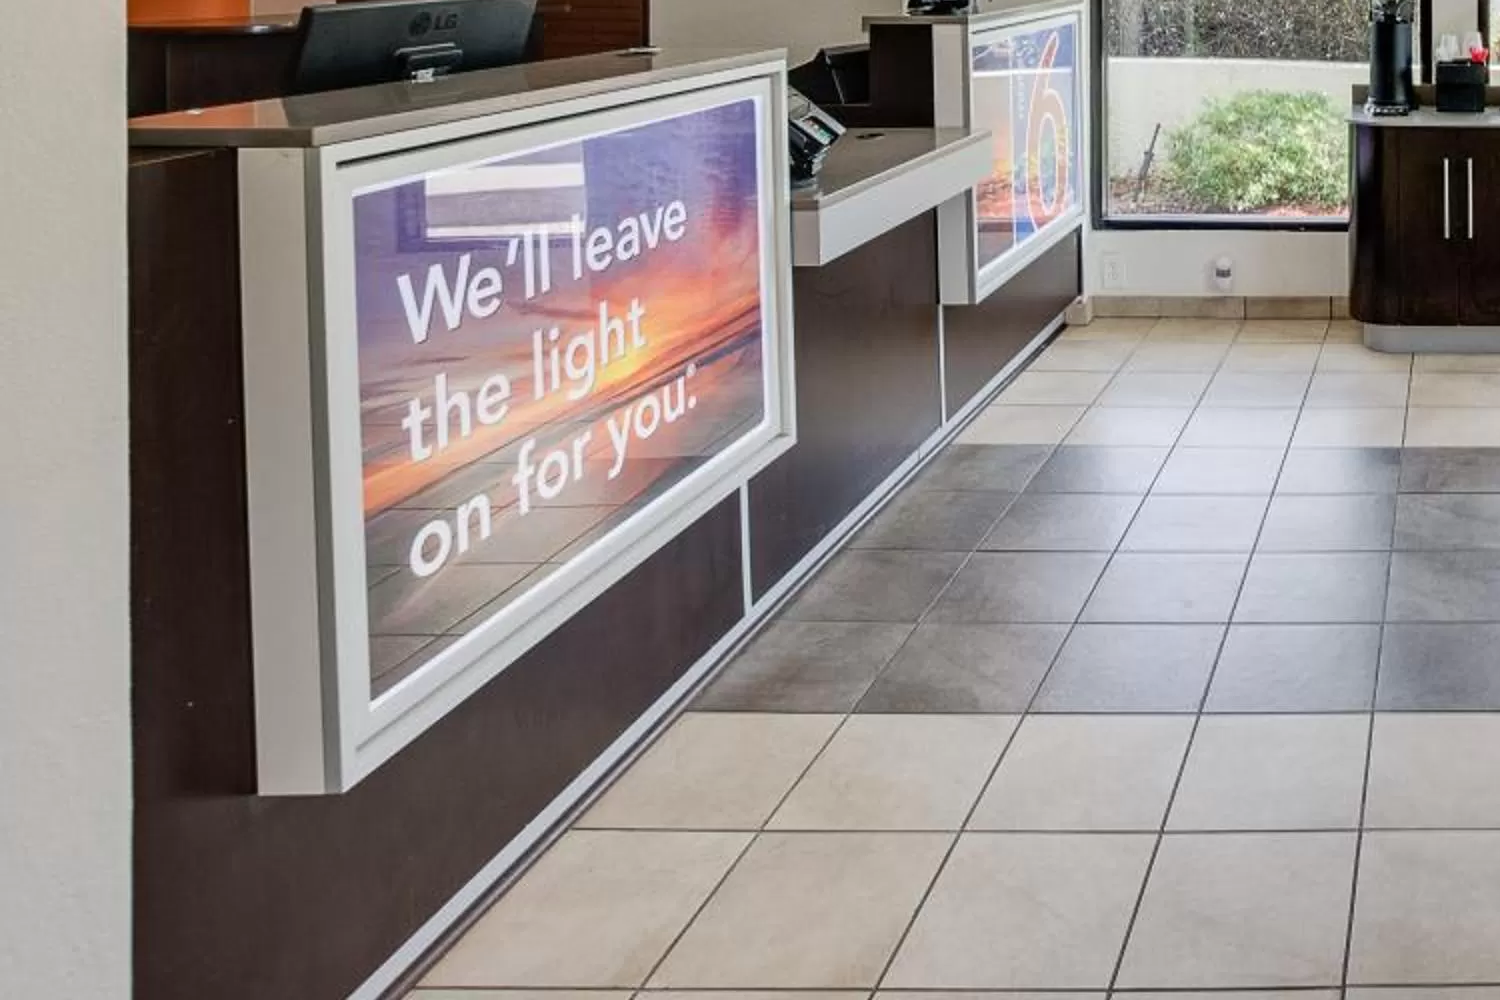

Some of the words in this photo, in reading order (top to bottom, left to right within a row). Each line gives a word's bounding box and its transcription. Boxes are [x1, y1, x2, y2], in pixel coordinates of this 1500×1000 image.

[434, 13, 458, 30] LG
[397, 224, 551, 344] We'll
[571, 200, 686, 279] leave
[402, 374, 511, 462] the
[533, 297, 646, 400] light
[409, 493, 491, 577] on
[512, 435, 590, 516] for
